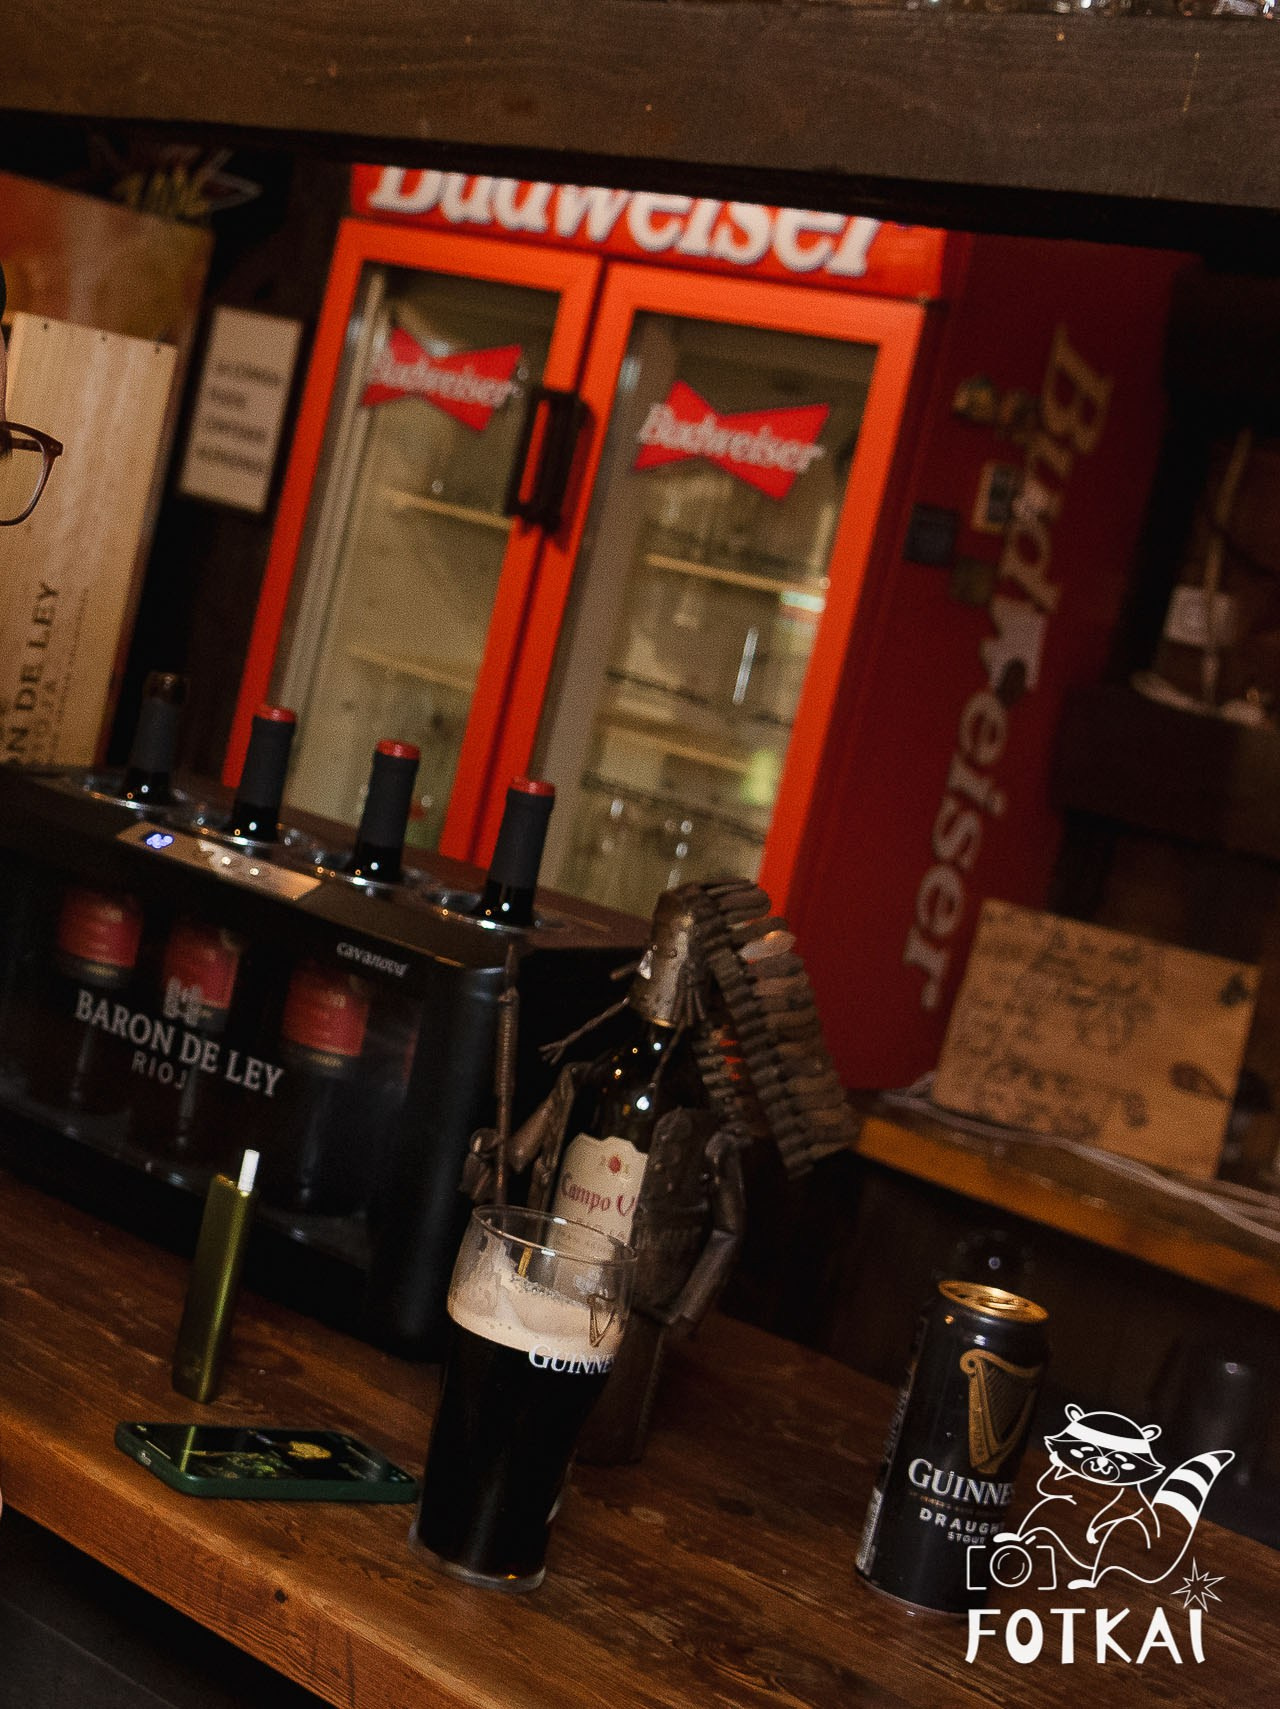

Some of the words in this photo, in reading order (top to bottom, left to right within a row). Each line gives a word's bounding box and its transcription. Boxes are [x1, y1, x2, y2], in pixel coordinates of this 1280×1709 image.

[637, 402, 825, 473] Budweiser
[26, 580, 60, 649] LEY
[16, 663, 46, 711] DE
[903, 325, 1115, 1008] Budeiser
[75, 989, 174, 1055] BARON
[179, 1032, 220, 1074] DE
[225, 1050, 285, 1098] LEY
[561, 1172, 612, 1215] Campo
[908, 1458, 1015, 1505] GUINNE
[919, 1507, 1004, 1536] DRAUGH
